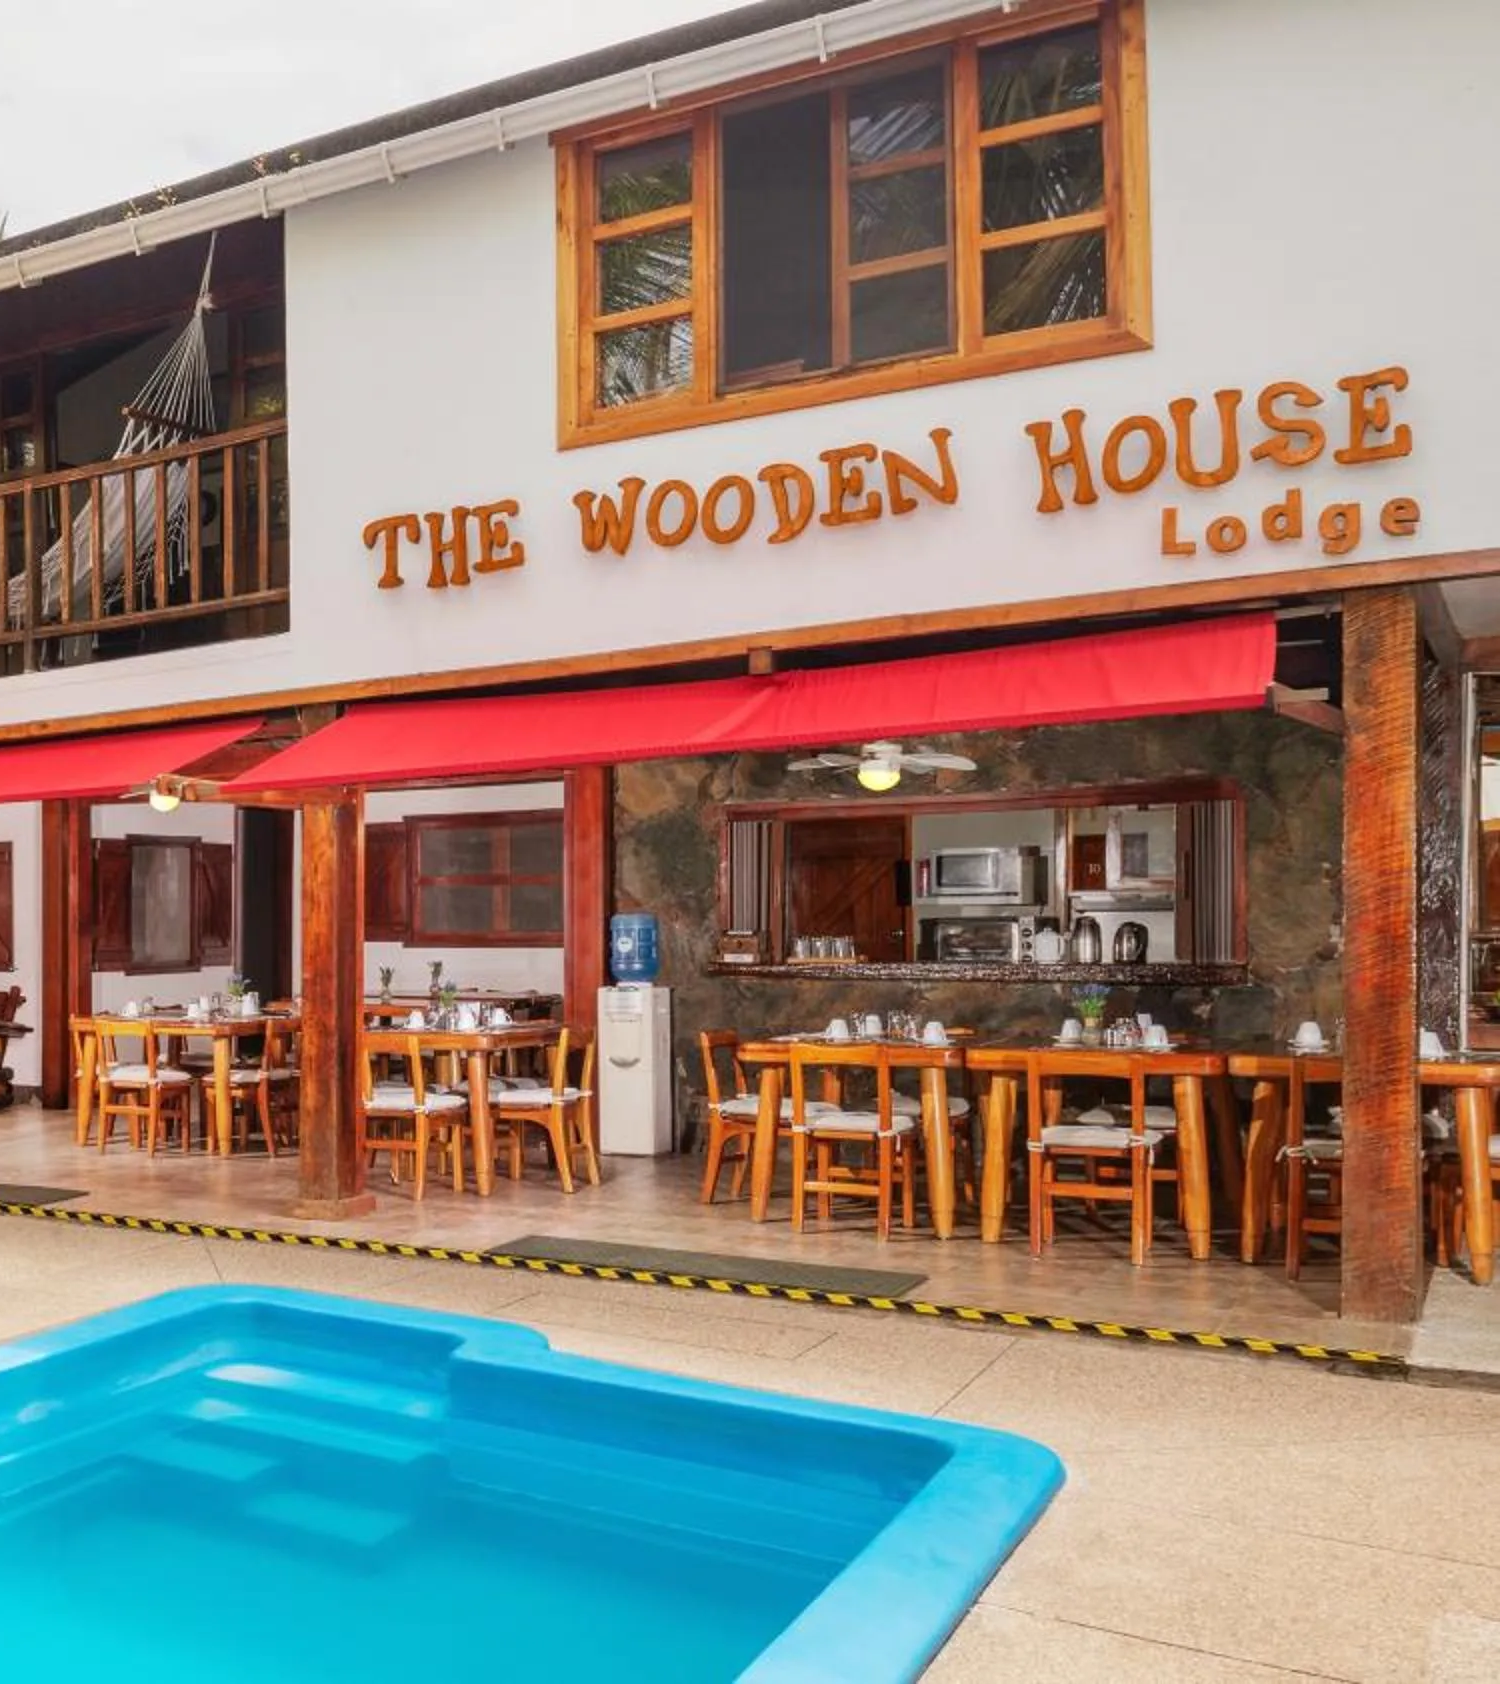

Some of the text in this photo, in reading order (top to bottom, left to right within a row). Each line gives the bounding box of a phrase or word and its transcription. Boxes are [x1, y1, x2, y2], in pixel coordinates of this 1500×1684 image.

[362, 366, 1414, 592] THE WOODEN HOUSE
[1160, 487, 1421, 559] Lodge
